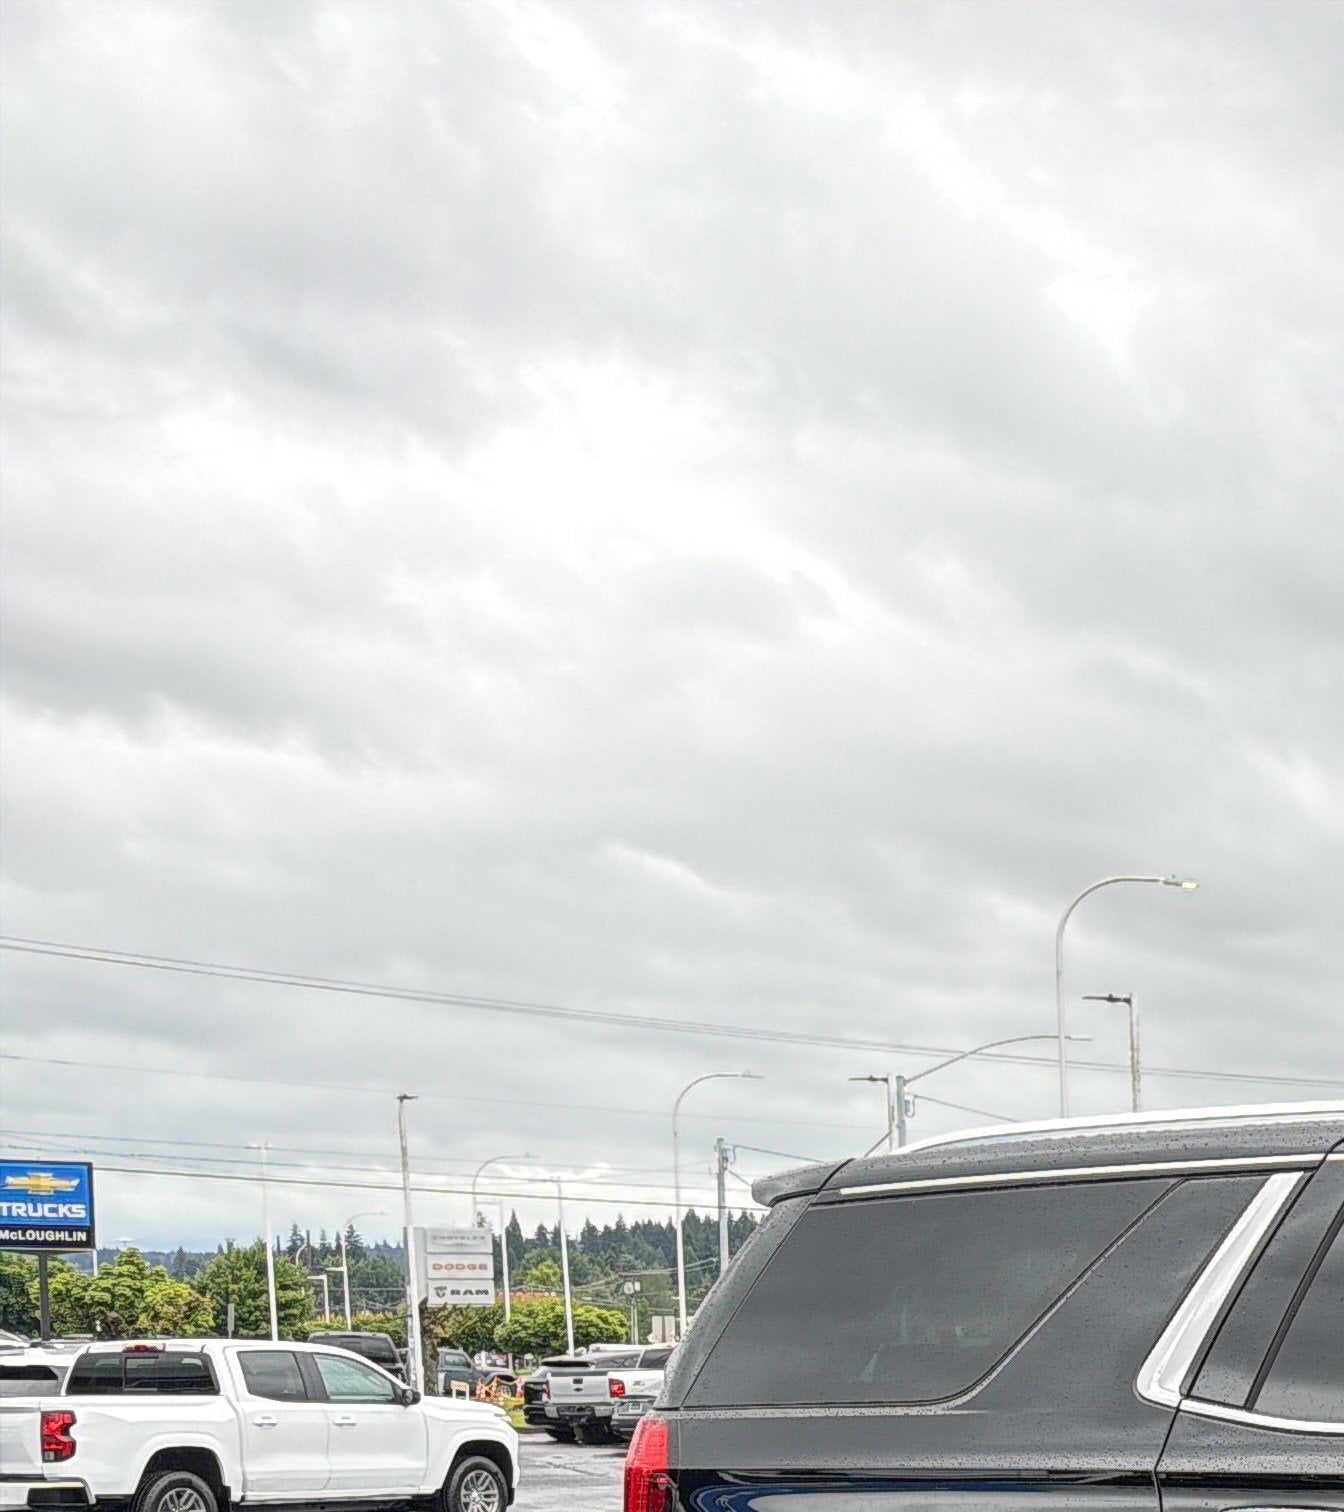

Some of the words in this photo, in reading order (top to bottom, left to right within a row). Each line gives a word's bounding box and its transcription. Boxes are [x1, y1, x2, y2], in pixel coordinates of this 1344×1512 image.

[0, 1202, 87, 1218] TRUCKS
[0, 1230, 87, 1241] McLOUGHLIN
[432, 1263, 488, 1271] DODGE
